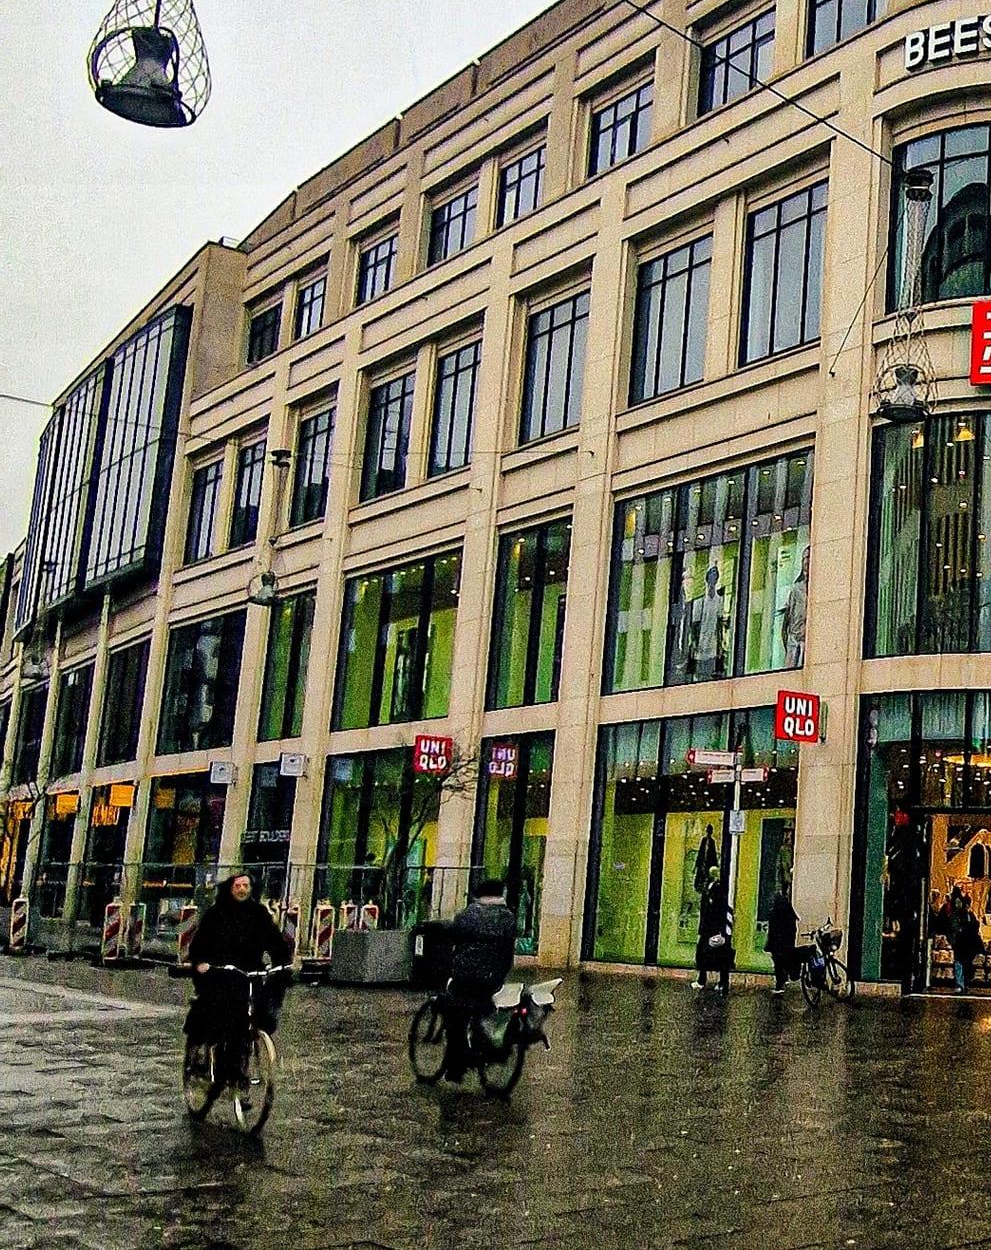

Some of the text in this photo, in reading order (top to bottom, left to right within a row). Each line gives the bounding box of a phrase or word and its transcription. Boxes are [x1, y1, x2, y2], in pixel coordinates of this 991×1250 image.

[785, 696, 813, 717] UNI
[784, 716, 815, 737] QLO
[421, 739, 446, 754] UNI
[419, 754, 447, 771] QLO
